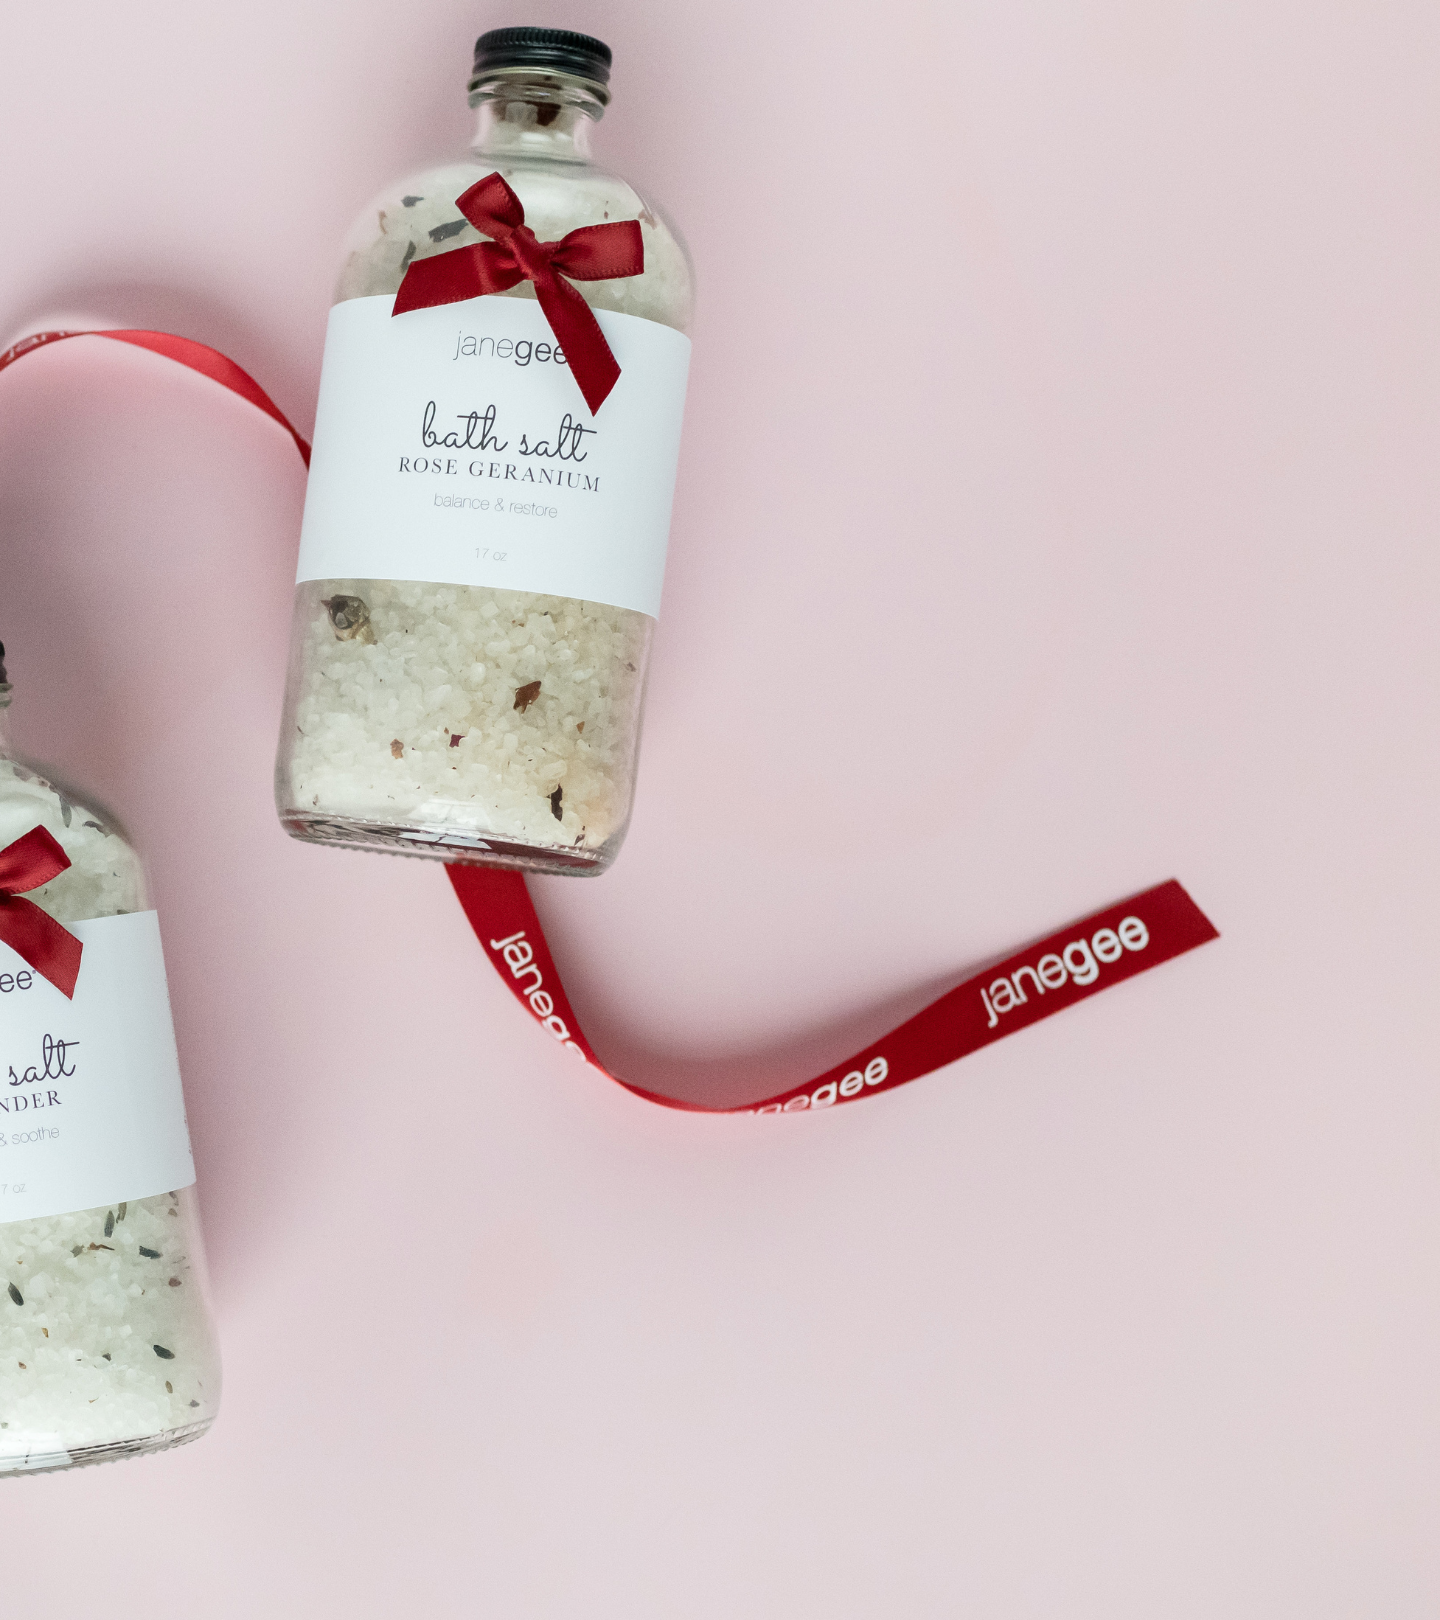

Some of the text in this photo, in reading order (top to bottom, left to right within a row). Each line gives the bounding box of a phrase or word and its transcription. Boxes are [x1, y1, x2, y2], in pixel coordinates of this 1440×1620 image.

[421, 400, 598, 463] bath salt
[398, 456, 600, 493] ROSE GERANIUM
[433, 492, 559, 519] balance & restore
[474, 547, 508, 562] 17 oz
[980, 915, 1150, 1029] janegee
[8, 1033, 81, 1087] salt
[11, 1126, 61, 1145] soothe
[11, 1182, 28, 1195] oz
